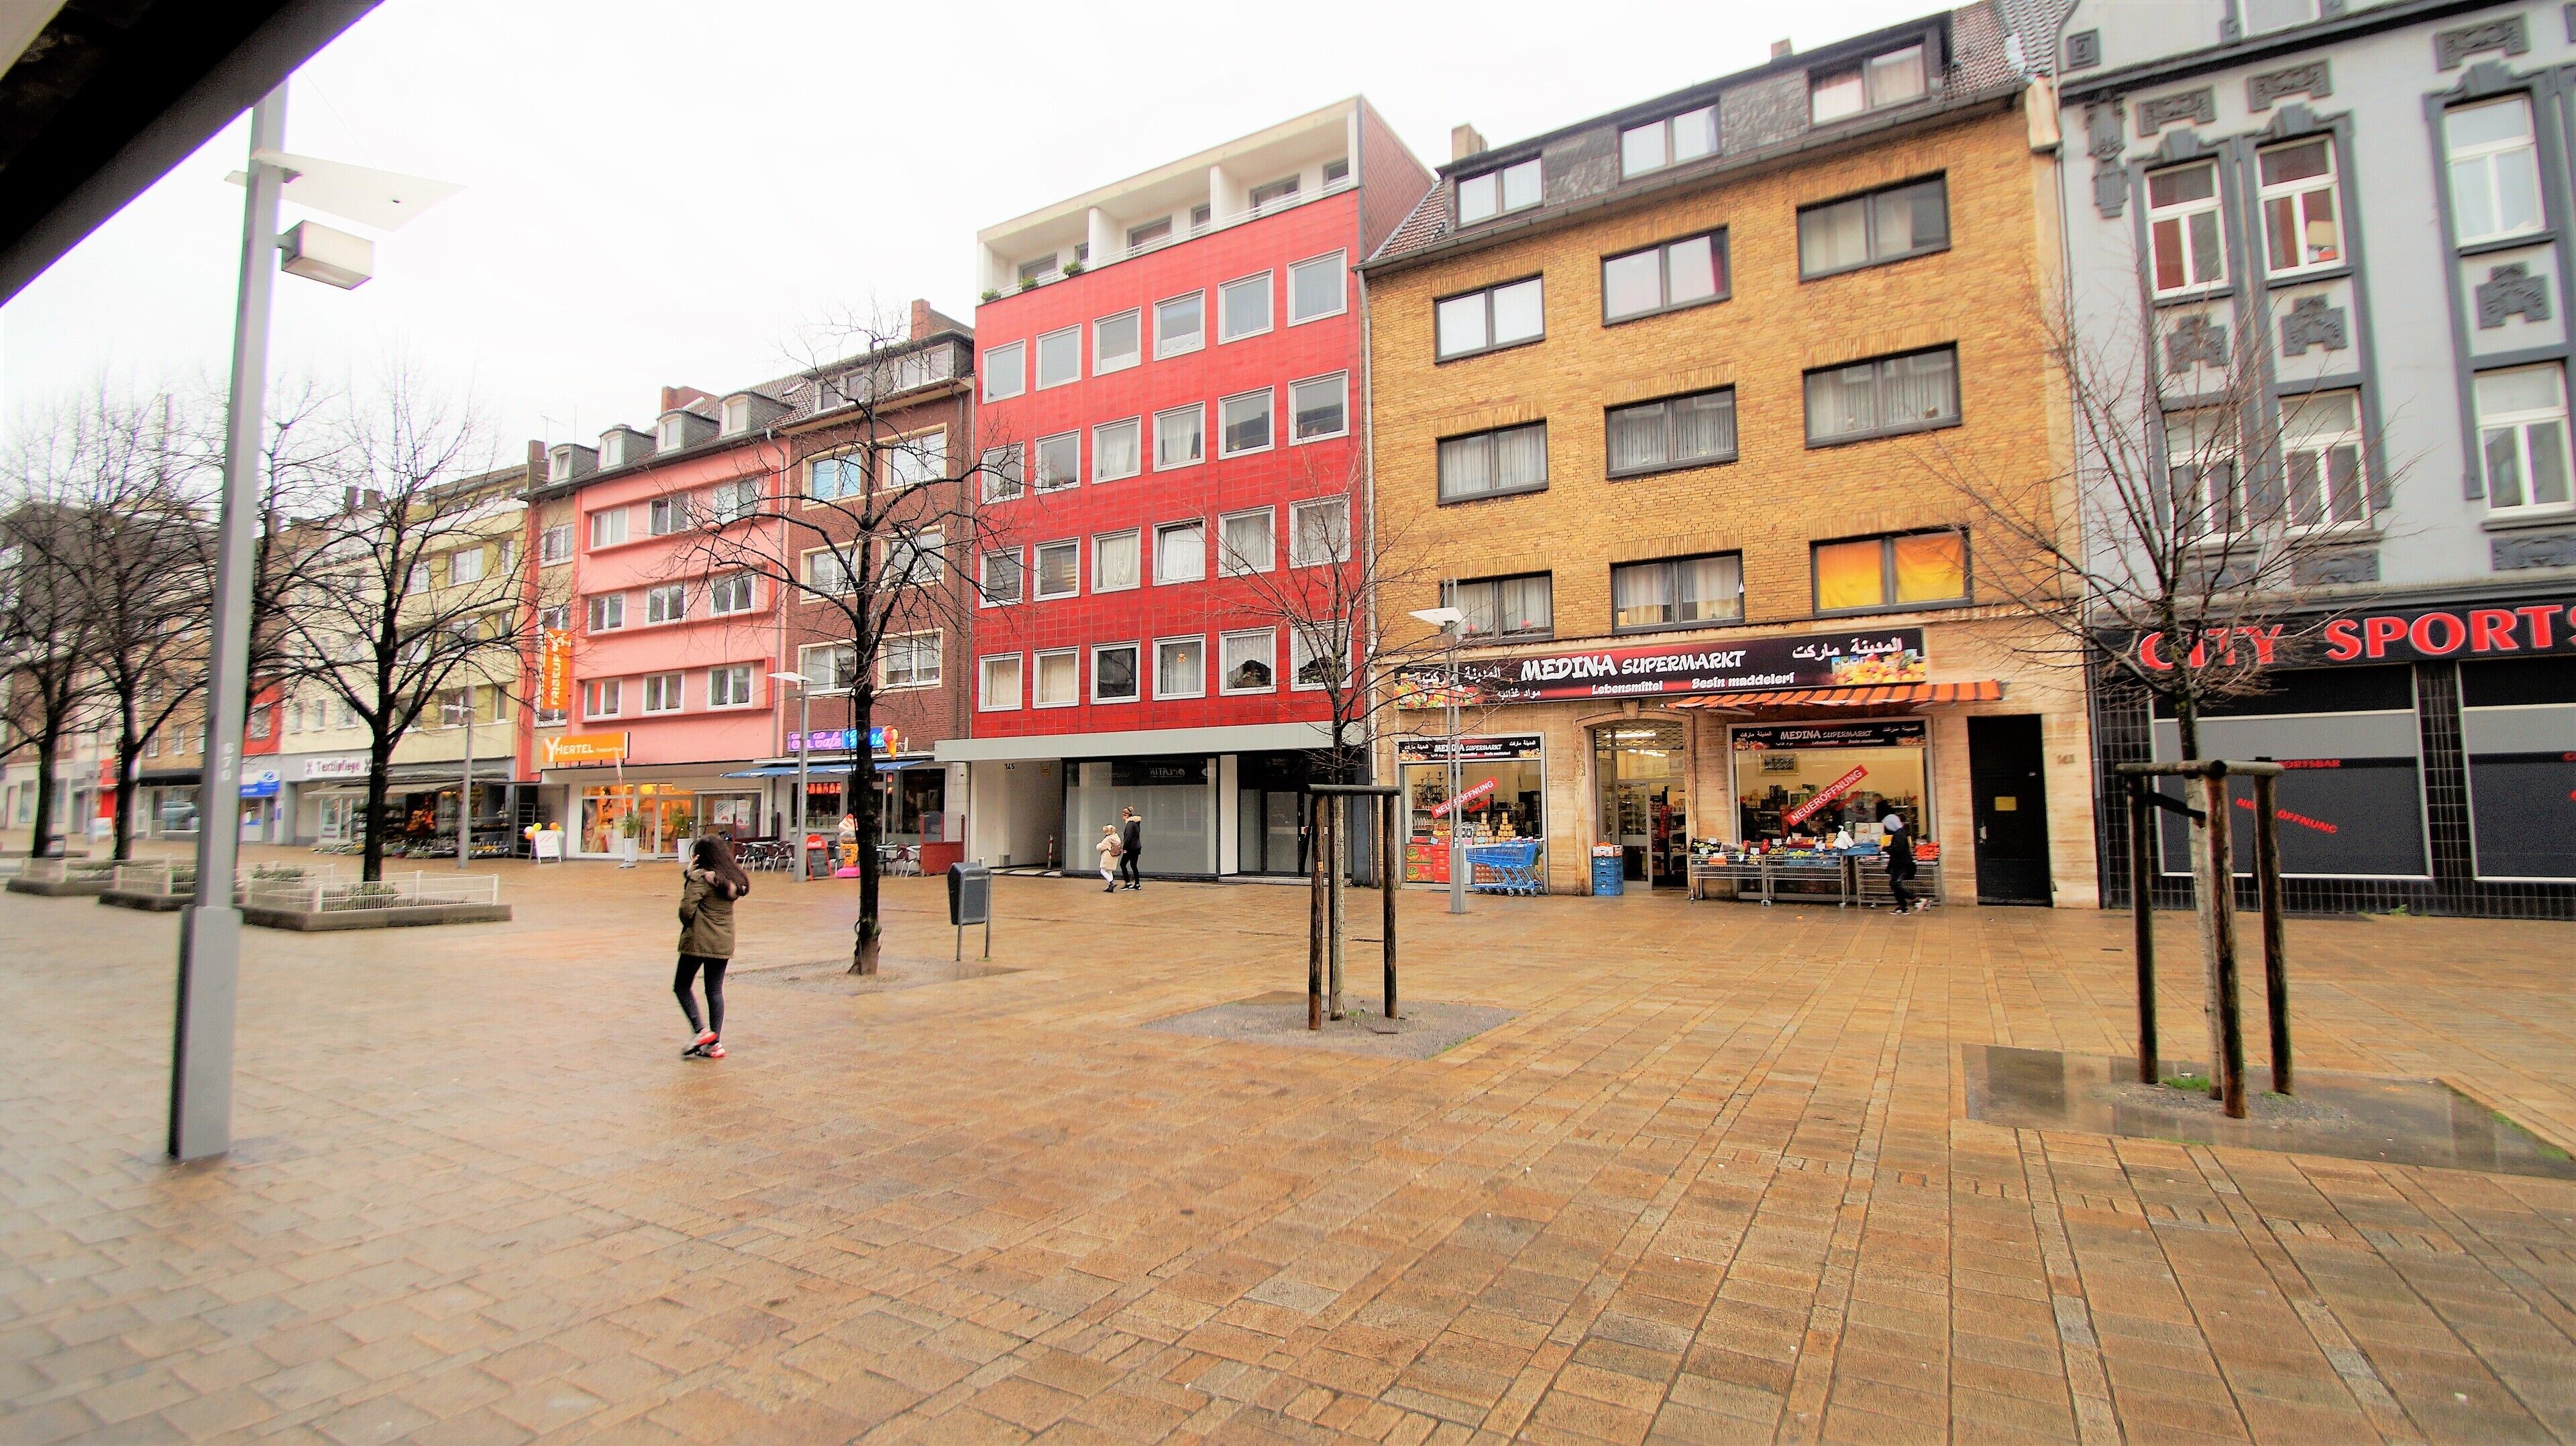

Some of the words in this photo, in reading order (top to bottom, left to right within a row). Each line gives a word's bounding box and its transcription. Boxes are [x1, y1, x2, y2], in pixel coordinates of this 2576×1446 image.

[2139, 624, 2283, 670] CITY
[2324, 604, 2576, 661] SPORT
[1792, 643, 1841, 661] ماركت
[1849, 637, 1903, 659] المدينة
[1520, 654, 1617, 681] MEDINA
[1621, 651, 1746, 675] SUPERMARKT
[1591, 679, 1664, 696] Lebensmittel
[1691, 677, 1725, 689] Besin
[1727, 673, 1795, 687] maddeleri
[1780, 730, 1821, 740] MEDINA
[1822, 730, 1873, 738] SUPERMARKT
[1465, 743, 1503, 751] SUPERMARKT
[1790, 769, 1863, 822] NEUERÖFFNUNG
